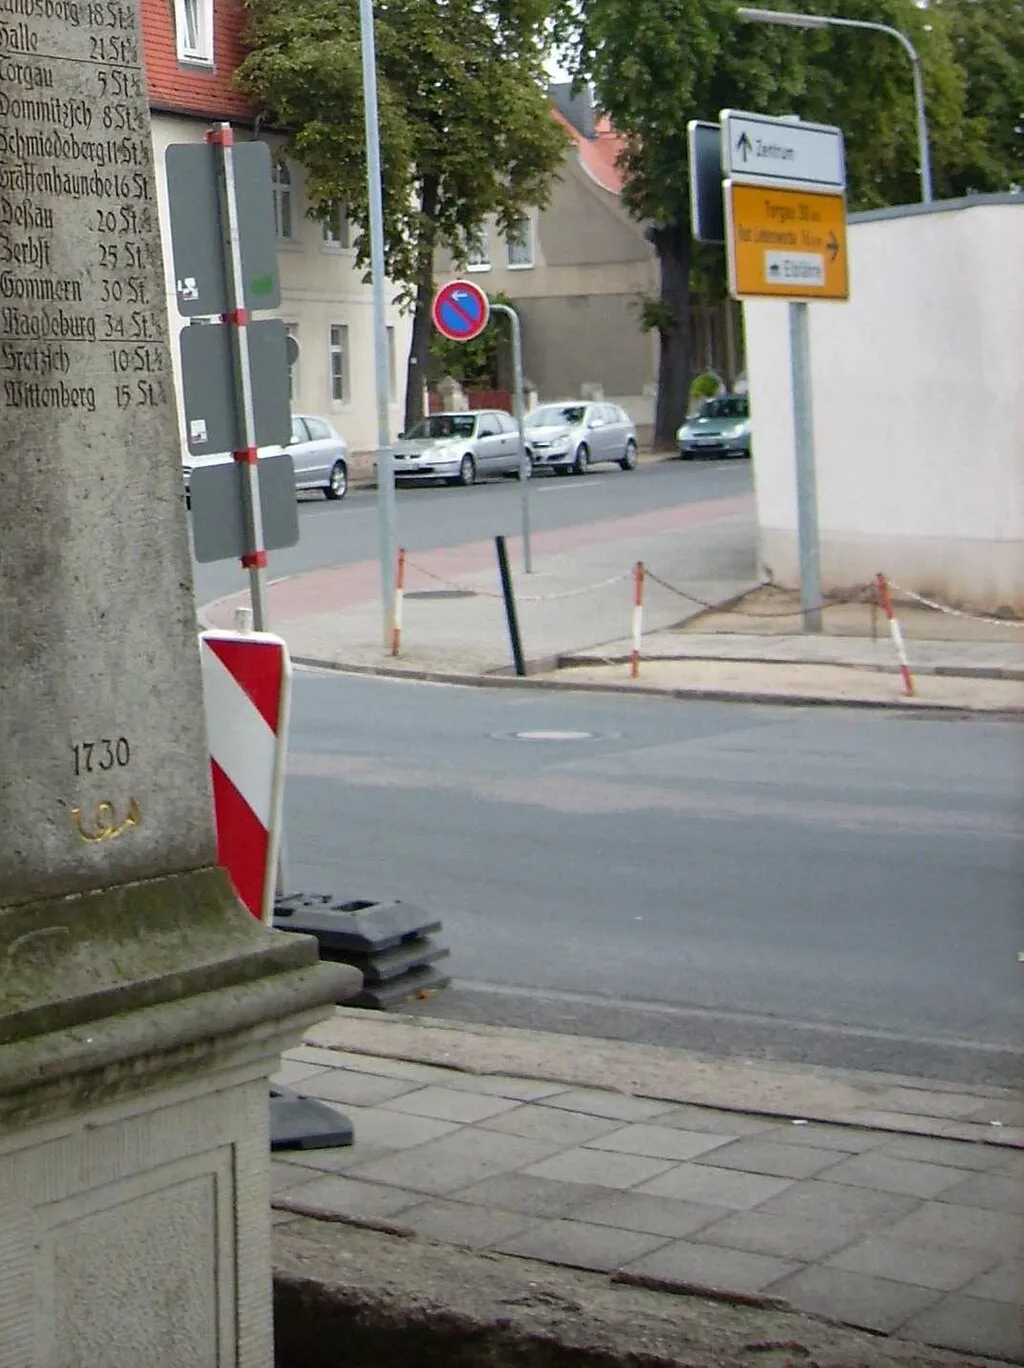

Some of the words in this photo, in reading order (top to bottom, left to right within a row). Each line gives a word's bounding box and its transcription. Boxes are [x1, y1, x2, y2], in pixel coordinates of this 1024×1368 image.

[89, 35, 106, 61] 21
[102, 105, 113, 129] 8
[95, 208, 117, 233] 20
[0, 269, 83, 303] Gommern
[99, 278, 124, 303] 30
[72, 736, 132, 777] 1730
